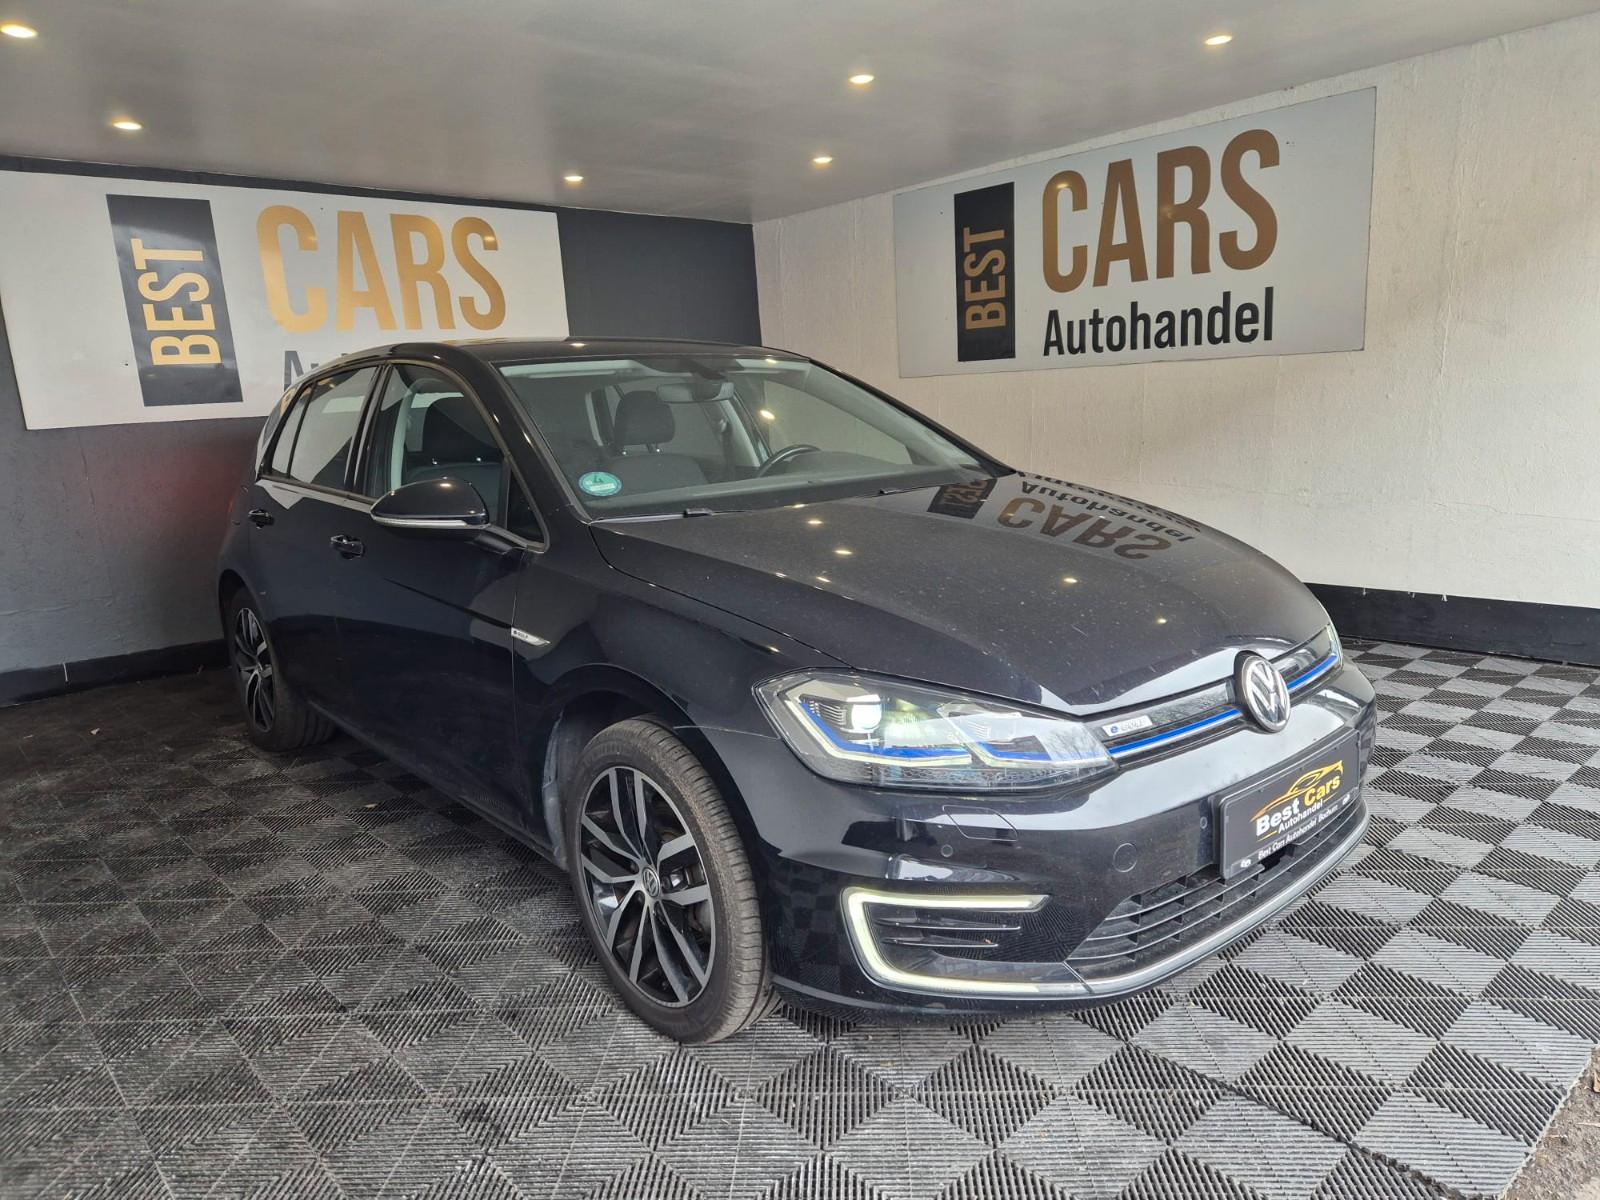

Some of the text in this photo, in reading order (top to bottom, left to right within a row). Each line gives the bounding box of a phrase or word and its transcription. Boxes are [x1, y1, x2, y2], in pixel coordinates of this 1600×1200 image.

[1042, 129, 1281, 293] CARS
[131, 238, 222, 366] BEST
[256, 204, 507, 333] CARS
[963, 226, 1007, 331] BEST
[1042, 286, 1275, 357] Autohandel
[1256, 775, 1341, 836] Best Cars
[1278, 798, 1323, 834] Autohandel
